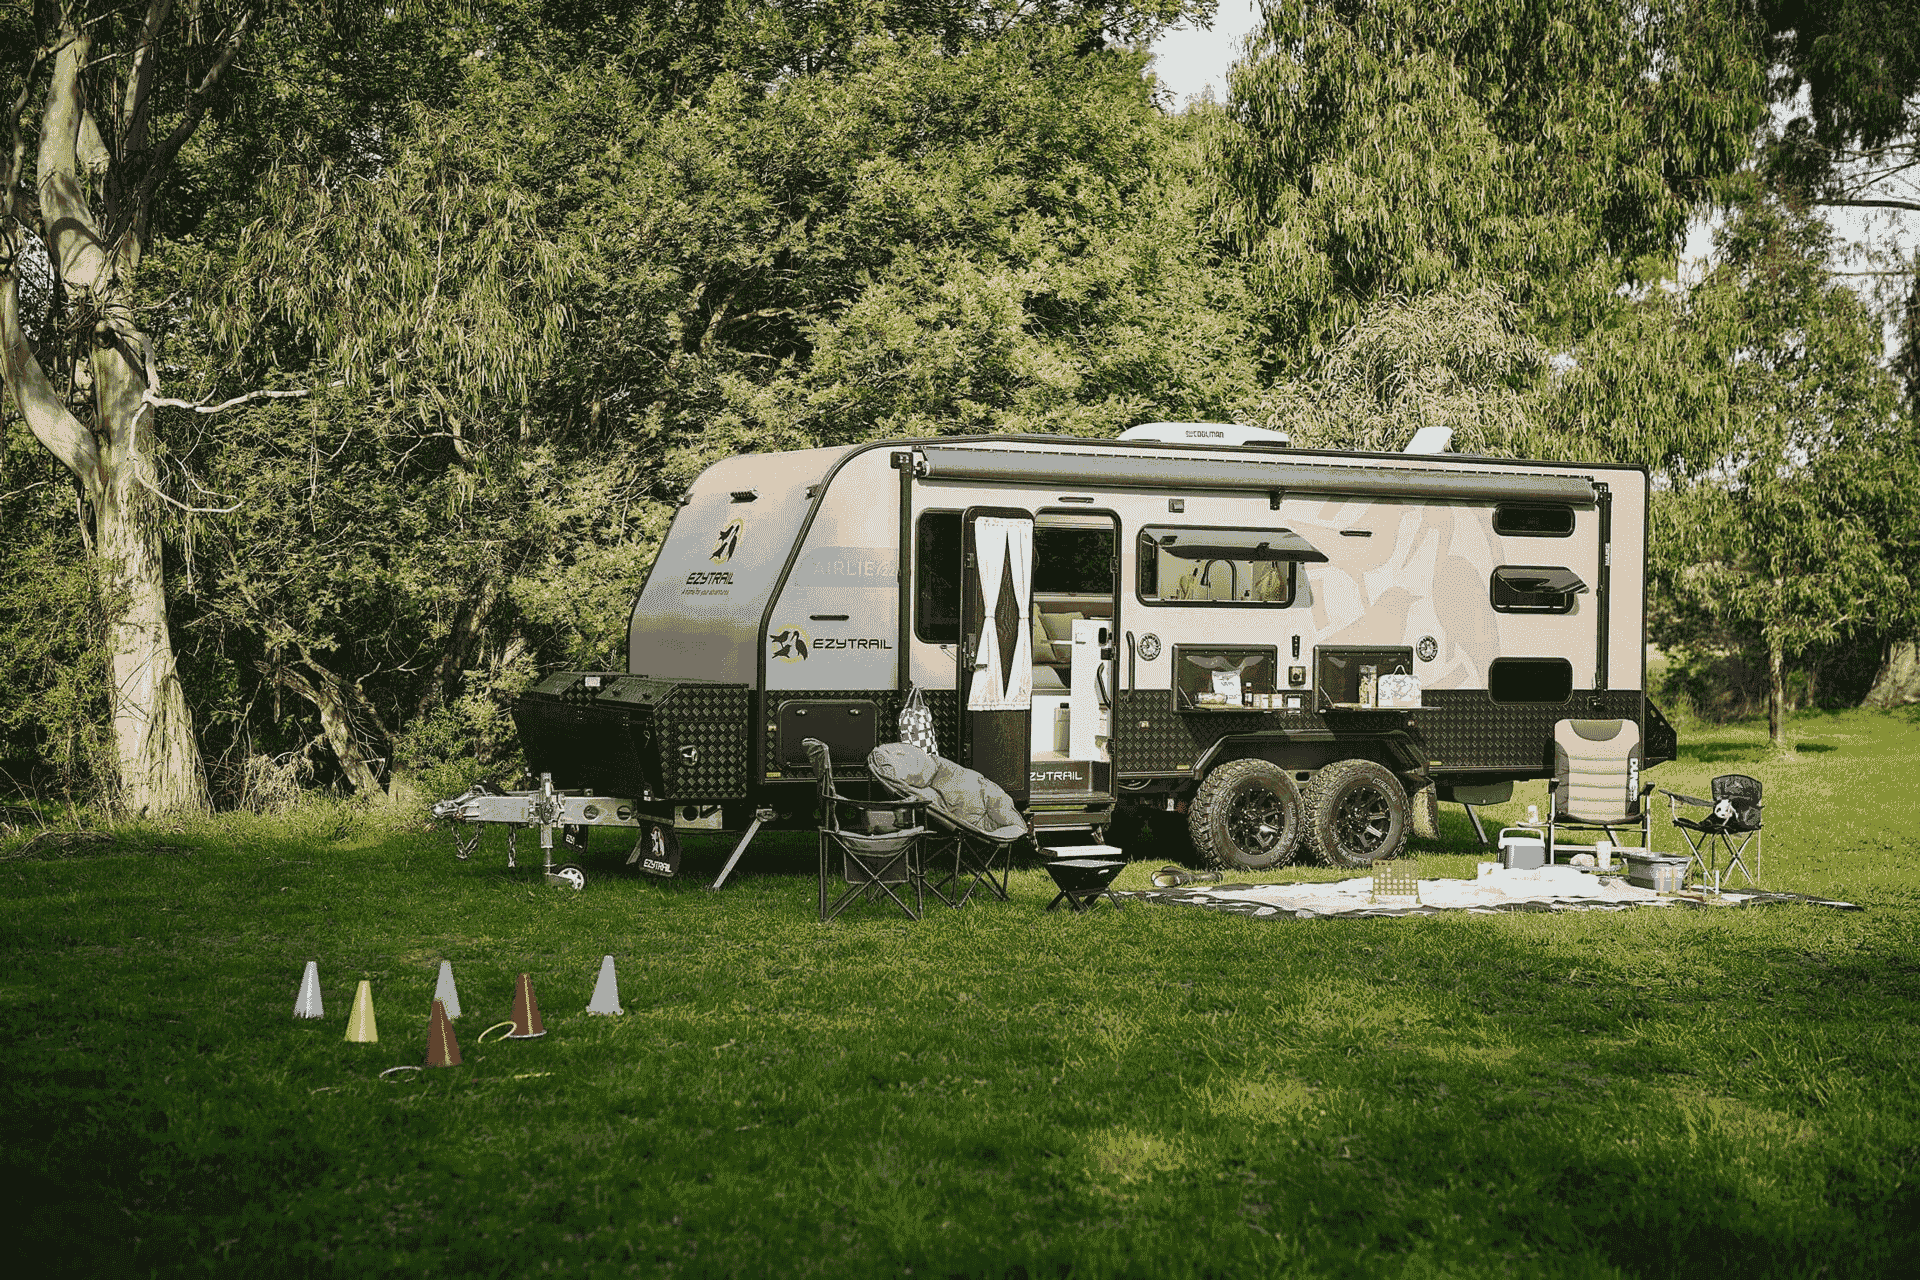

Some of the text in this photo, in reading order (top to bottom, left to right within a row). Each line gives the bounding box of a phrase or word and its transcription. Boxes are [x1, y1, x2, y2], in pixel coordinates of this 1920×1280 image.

[686, 571, 734, 585] EZYTRAIL
[813, 638, 893, 650] EZYTRAIL
[1029, 771, 1083, 781] ZYTRAIL
[643, 858, 672, 872] EZYTRAIL
